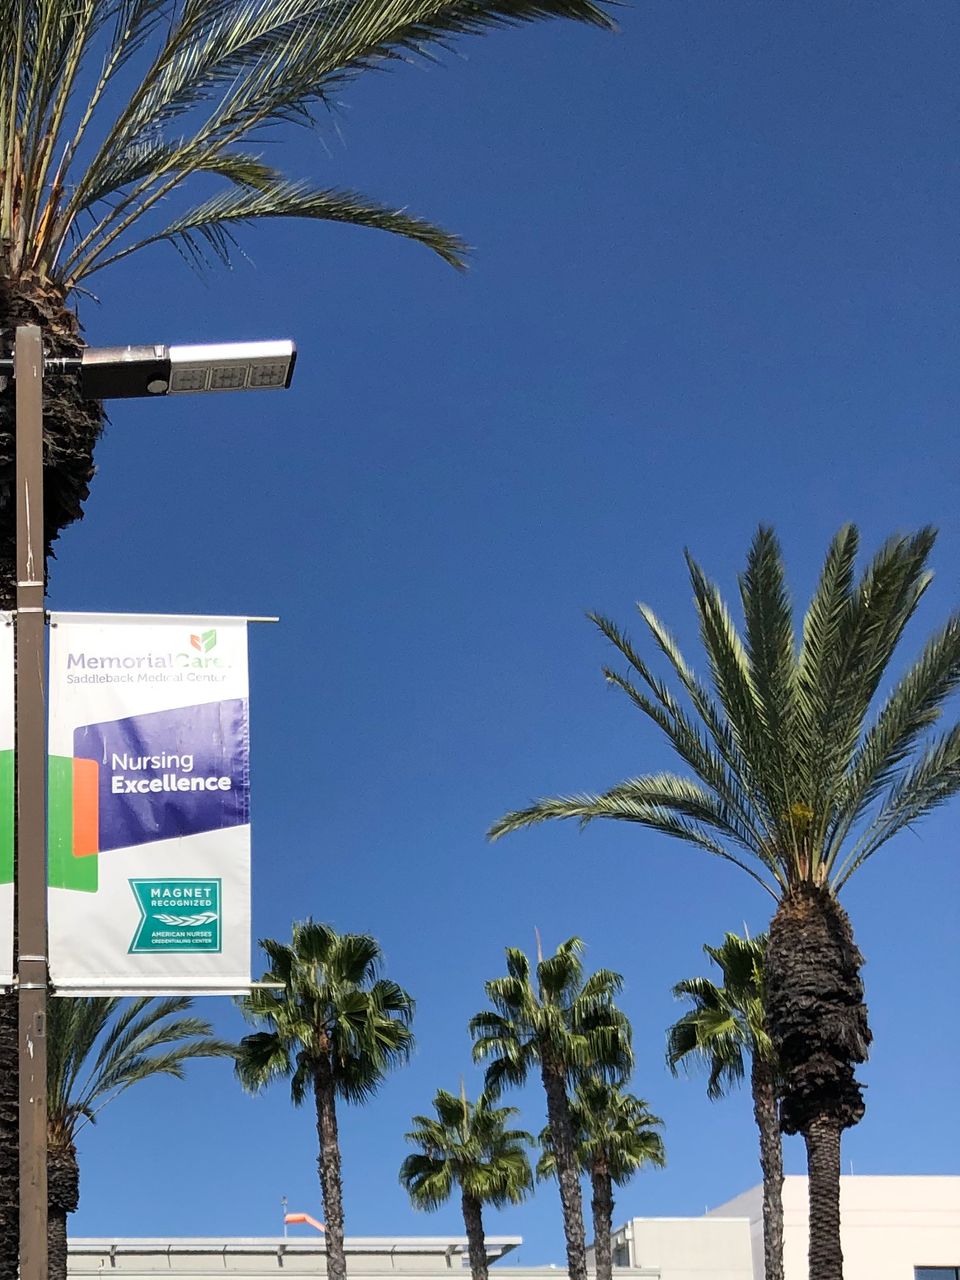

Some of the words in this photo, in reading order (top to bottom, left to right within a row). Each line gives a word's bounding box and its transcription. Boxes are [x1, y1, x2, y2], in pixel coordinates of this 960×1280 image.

[67, 673, 134, 684] Saddleback
[112, 752, 194, 773] Nursing
[111, 773, 232, 794] Excellence
[150, 888, 212, 898] MAGNET
